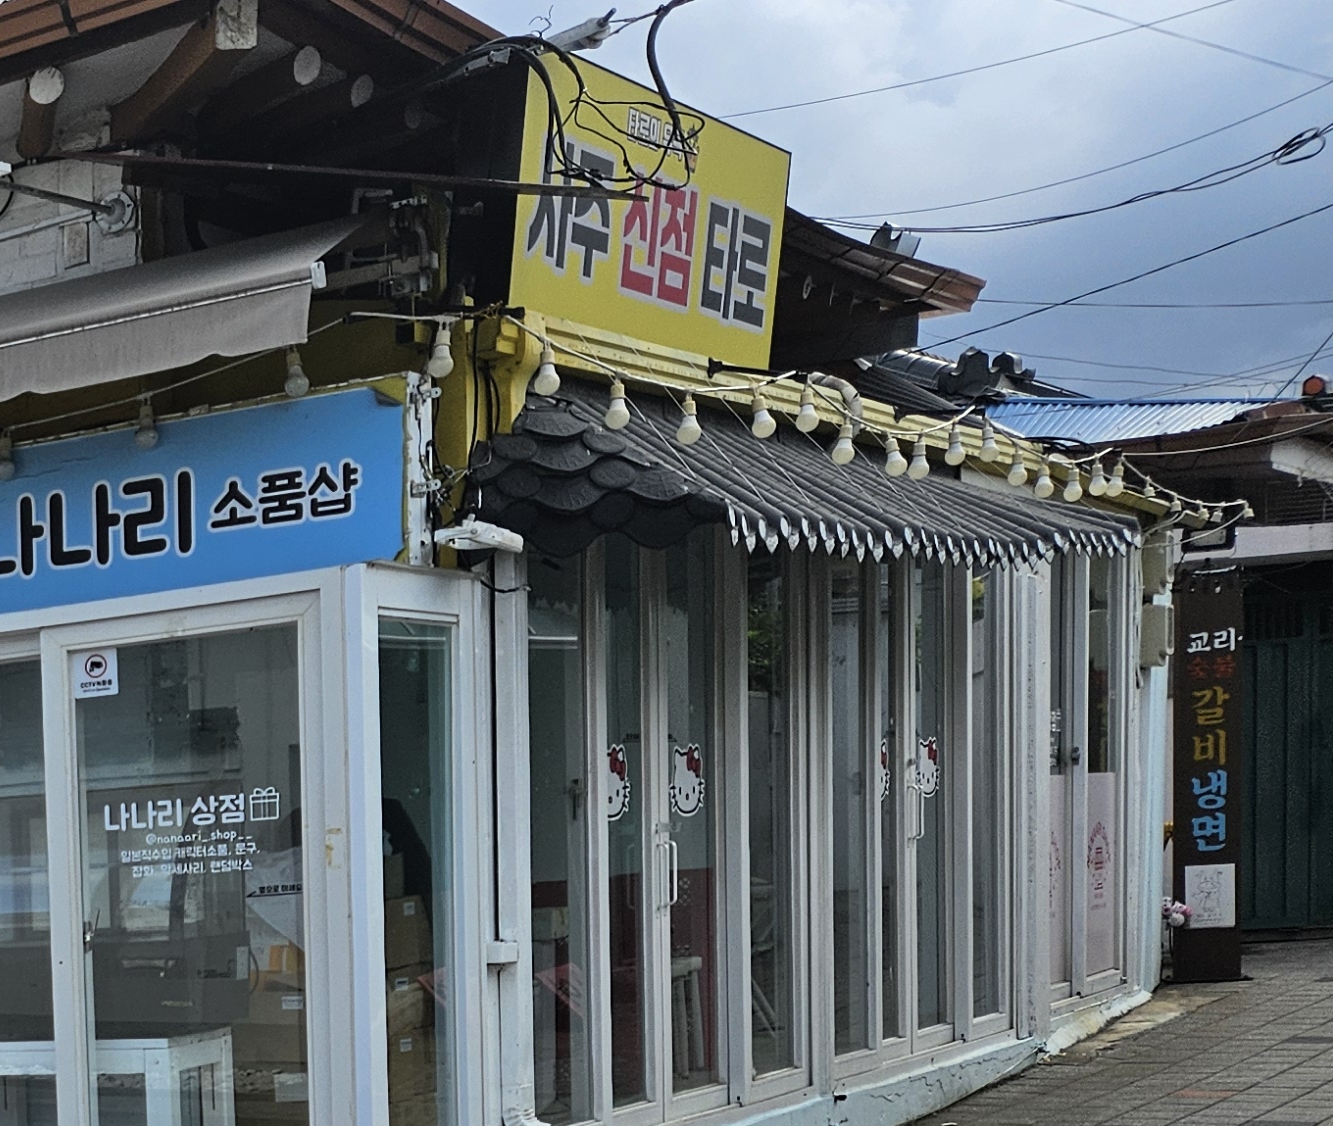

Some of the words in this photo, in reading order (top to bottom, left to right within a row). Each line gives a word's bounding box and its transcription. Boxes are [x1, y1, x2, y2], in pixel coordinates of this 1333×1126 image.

[627, 106, 662, 152] 타로의
[527, 137, 615, 280] 사주
[620, 172, 699, 308] 신점
[701, 200, 773, 328] 타로
[209, 458, 361, 530] 소품샵
[1186, 627, 1237, 654] 교리
[1192, 685, 1231, 767] 갈비
[104, 797, 183, 831] 나나리
[191, 793, 245, 826] 상점
[1191, 769, 1229, 853] 냉면
